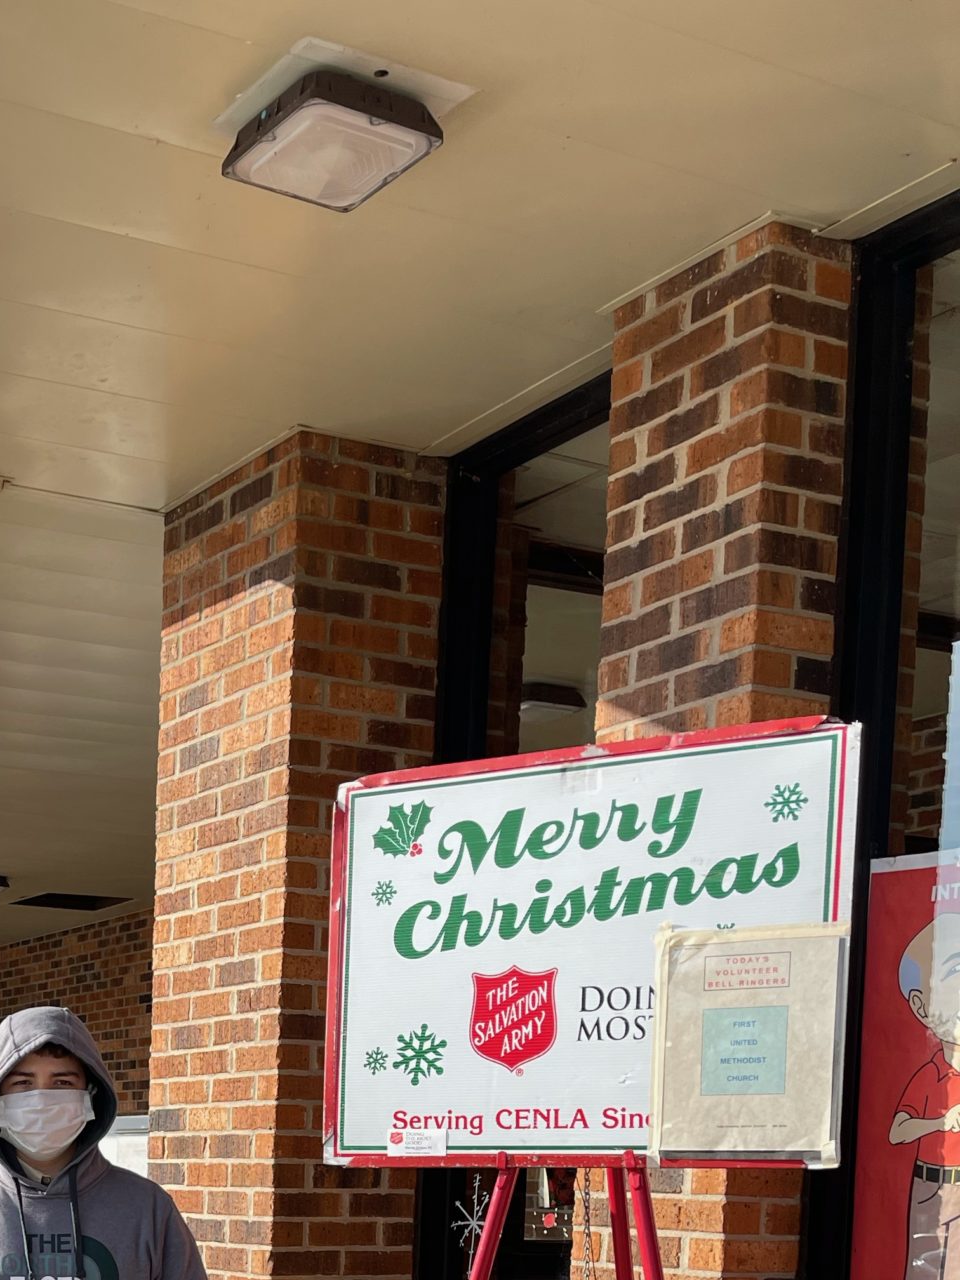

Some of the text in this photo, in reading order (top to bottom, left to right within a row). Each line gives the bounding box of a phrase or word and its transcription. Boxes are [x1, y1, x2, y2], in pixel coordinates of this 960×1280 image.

[434, 788, 703, 885] Merry
[394, 842, 800, 959] Christmas
[725, 956, 769, 965] TODAY'S
[715, 966, 779, 977] VOLUNTEER
[707, 977, 787, 989] BELL RINGERS
[486, 977, 519, 1010] THE
[474, 981, 548, 1047] SALVATION
[732, 1020, 757, 1028] FIRST
[501, 1011, 546, 1057] ARMY
[576, 1015, 655, 1042] MOS
[730, 1039, 758, 1047] UNITED
[720, 1056, 767, 1065] METHODIST
[726, 1074, 760, 1082] CHURCH
[392, 1109, 484, 1136] Serving
[495, 1108, 590, 1130] CENLA
[25, 1234, 72, 1254] THE
